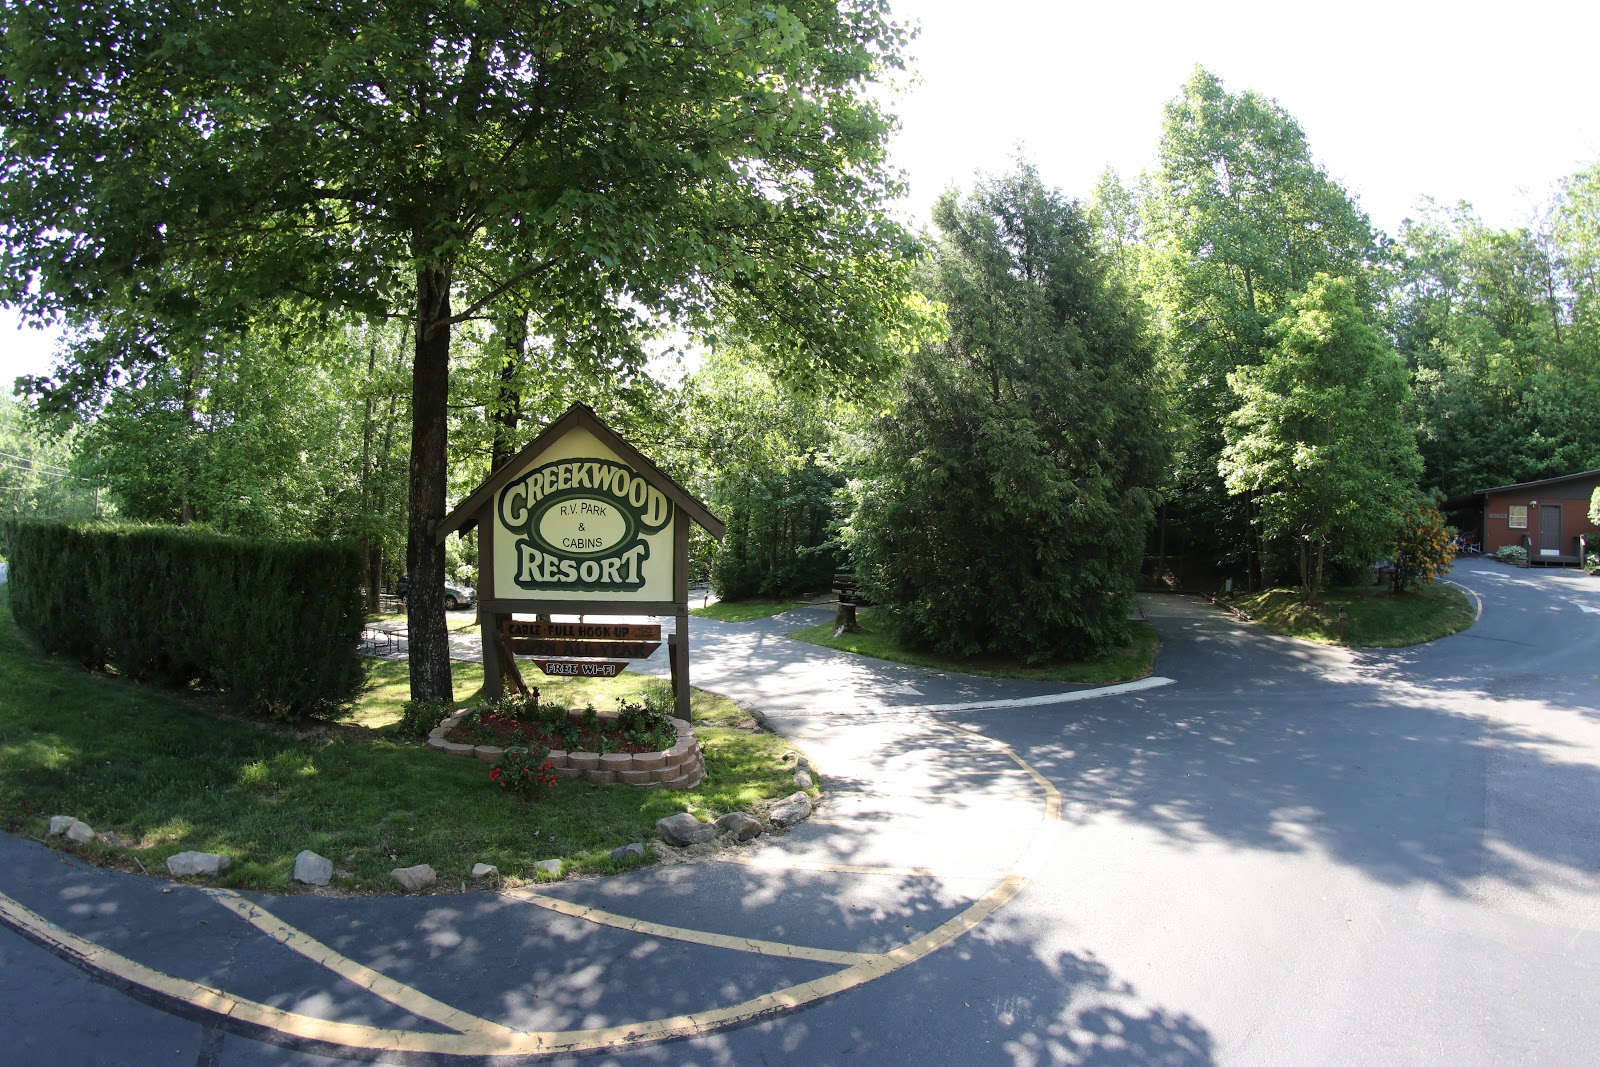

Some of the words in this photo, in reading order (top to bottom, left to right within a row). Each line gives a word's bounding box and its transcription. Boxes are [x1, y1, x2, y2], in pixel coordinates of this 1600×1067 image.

[502, 462, 668, 527] CREEKWOOD
[560, 504, 578, 516] R.V.
[580, 502, 607, 517] PARK
[578, 522, 586, 532] &
[562, 537, 603, 549] CABINS
[518, 543, 646, 584] RESORT
[508, 624, 541, 636] CABLE
[548, 625, 576, 637] FULL
[578, 626, 611, 638] HOOK
[614, 627, 630, 638] UP
[563, 642, 591, 656] ALL
[601, 643, 645, 657] YEAR
[545, 663, 578, 674] FREE
[582, 663, 616, 675] WI-FI
